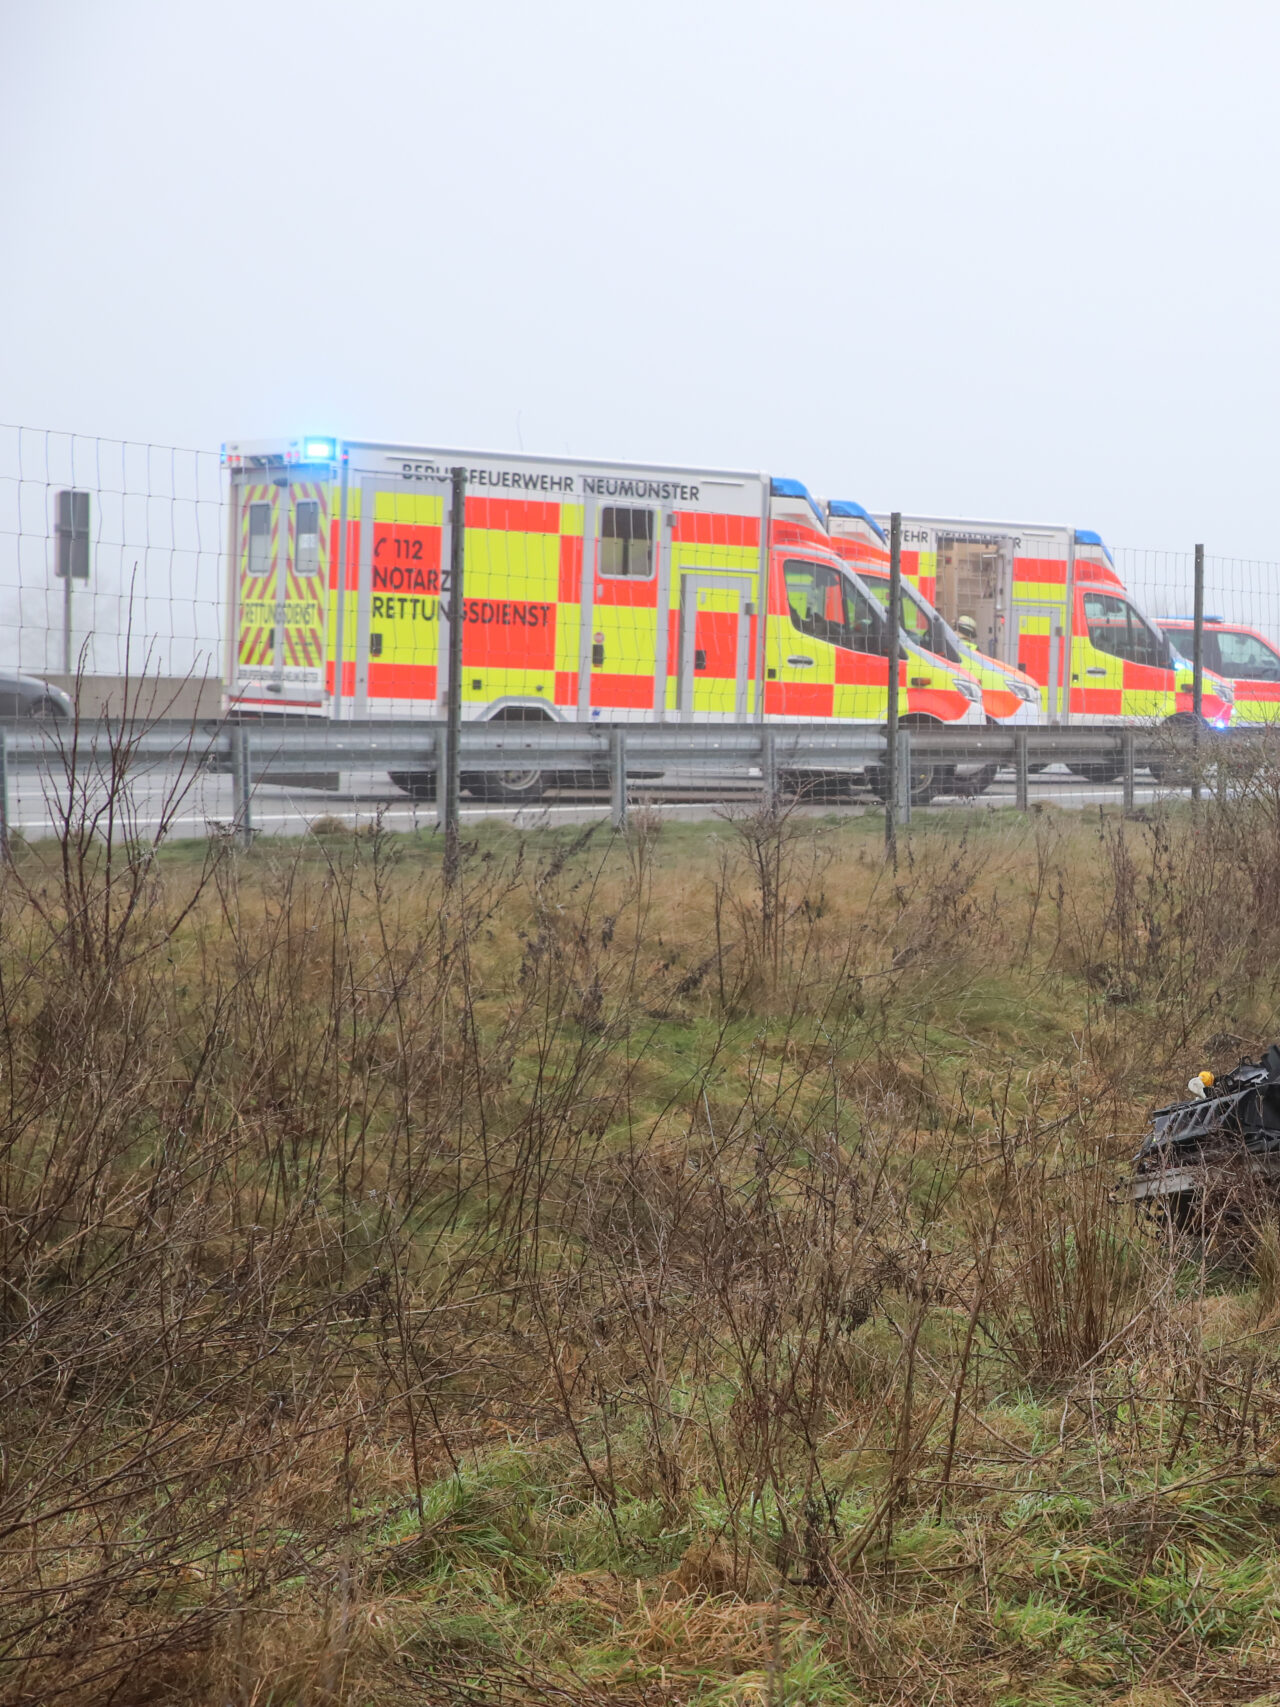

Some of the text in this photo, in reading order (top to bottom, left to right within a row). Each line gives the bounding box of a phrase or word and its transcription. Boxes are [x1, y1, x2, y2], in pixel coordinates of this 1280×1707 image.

[402, 463, 699, 501] BERUFEUERWEHR NEUMÜNSTER
[394, 539, 423, 560] 112
[372, 565, 452, 592] NOTARZ
[372, 596, 550, 627] RETTUNSDIENST
